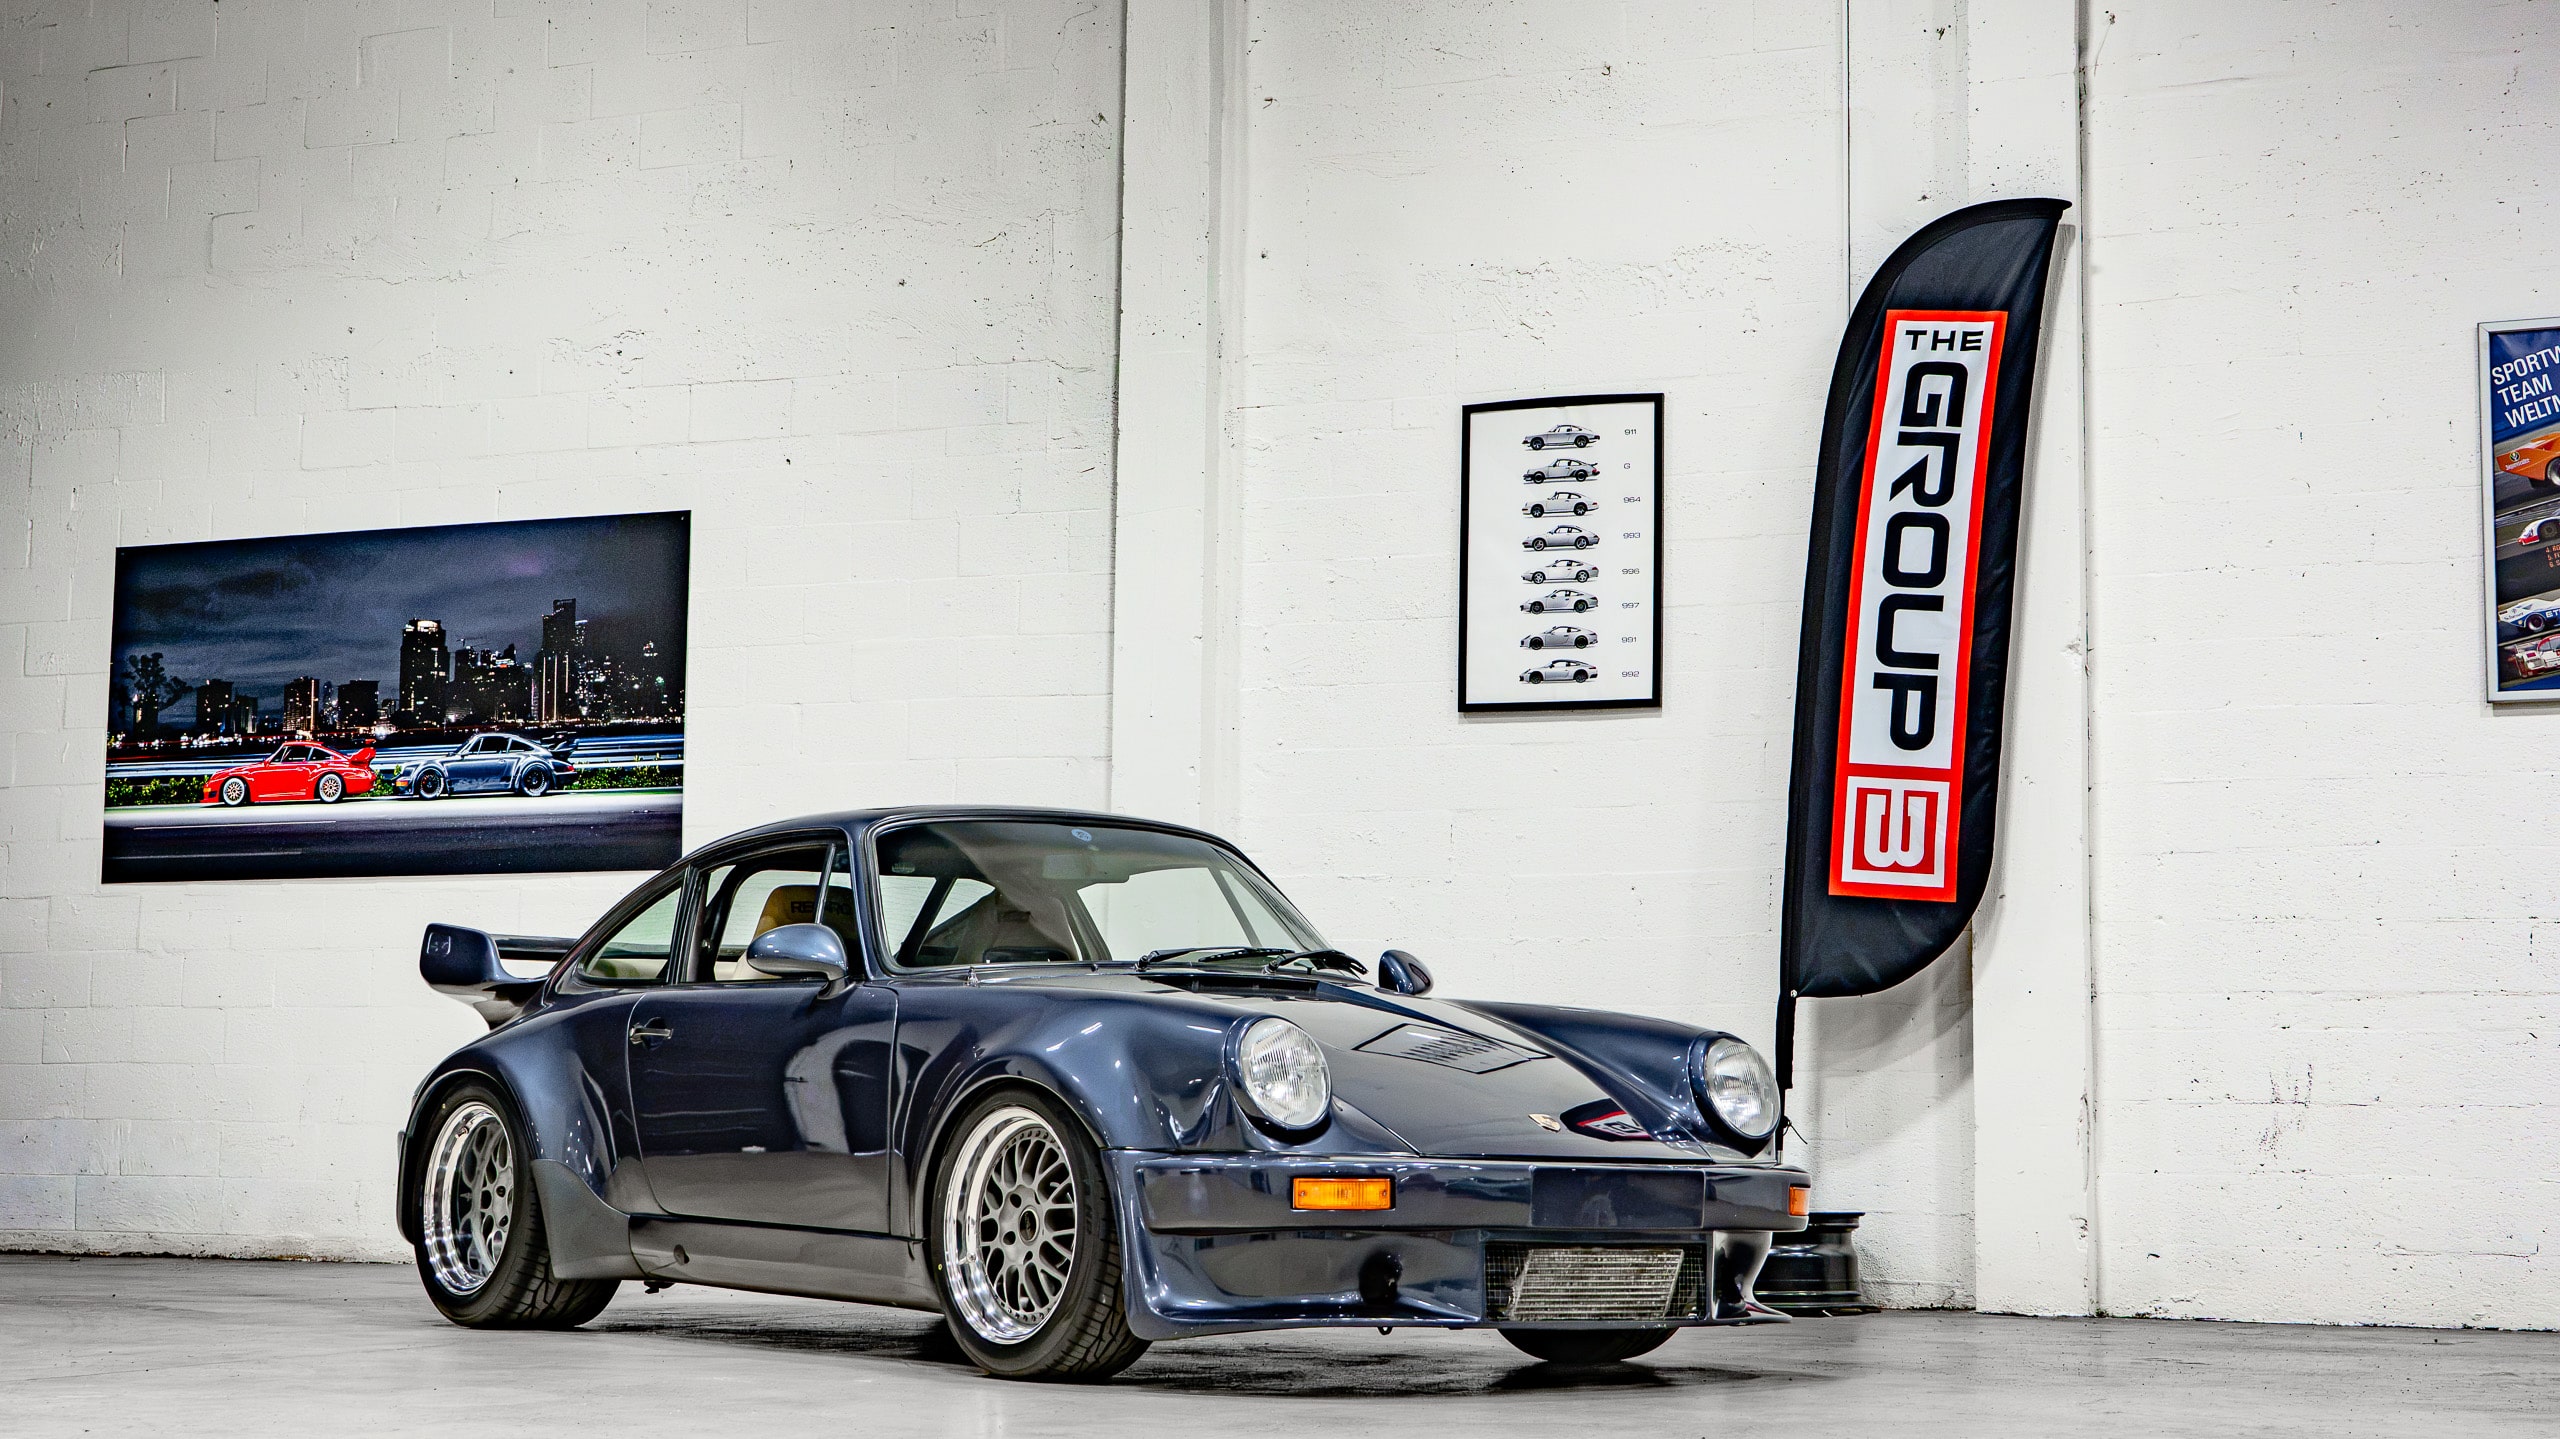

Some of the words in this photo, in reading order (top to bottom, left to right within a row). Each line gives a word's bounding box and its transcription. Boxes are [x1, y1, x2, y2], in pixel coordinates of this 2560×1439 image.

[1905, 329, 1984, 352] THE
[2497, 373, 2553, 406] TEAM
[1624, 428, 1637, 436] 911
[1623, 462, 1631, 470] G
[1623, 496, 1641, 504] 964
[1622, 532, 1641, 540] 993
[1872, 361, 1969, 752] GROUP
[1621, 602, 1640, 610] 997
[2545, 608, 2560, 618] ET
[1621, 636, 1637, 644] 991
[1621, 670, 1640, 678] 992
[790, 901, 852, 915] RERO
